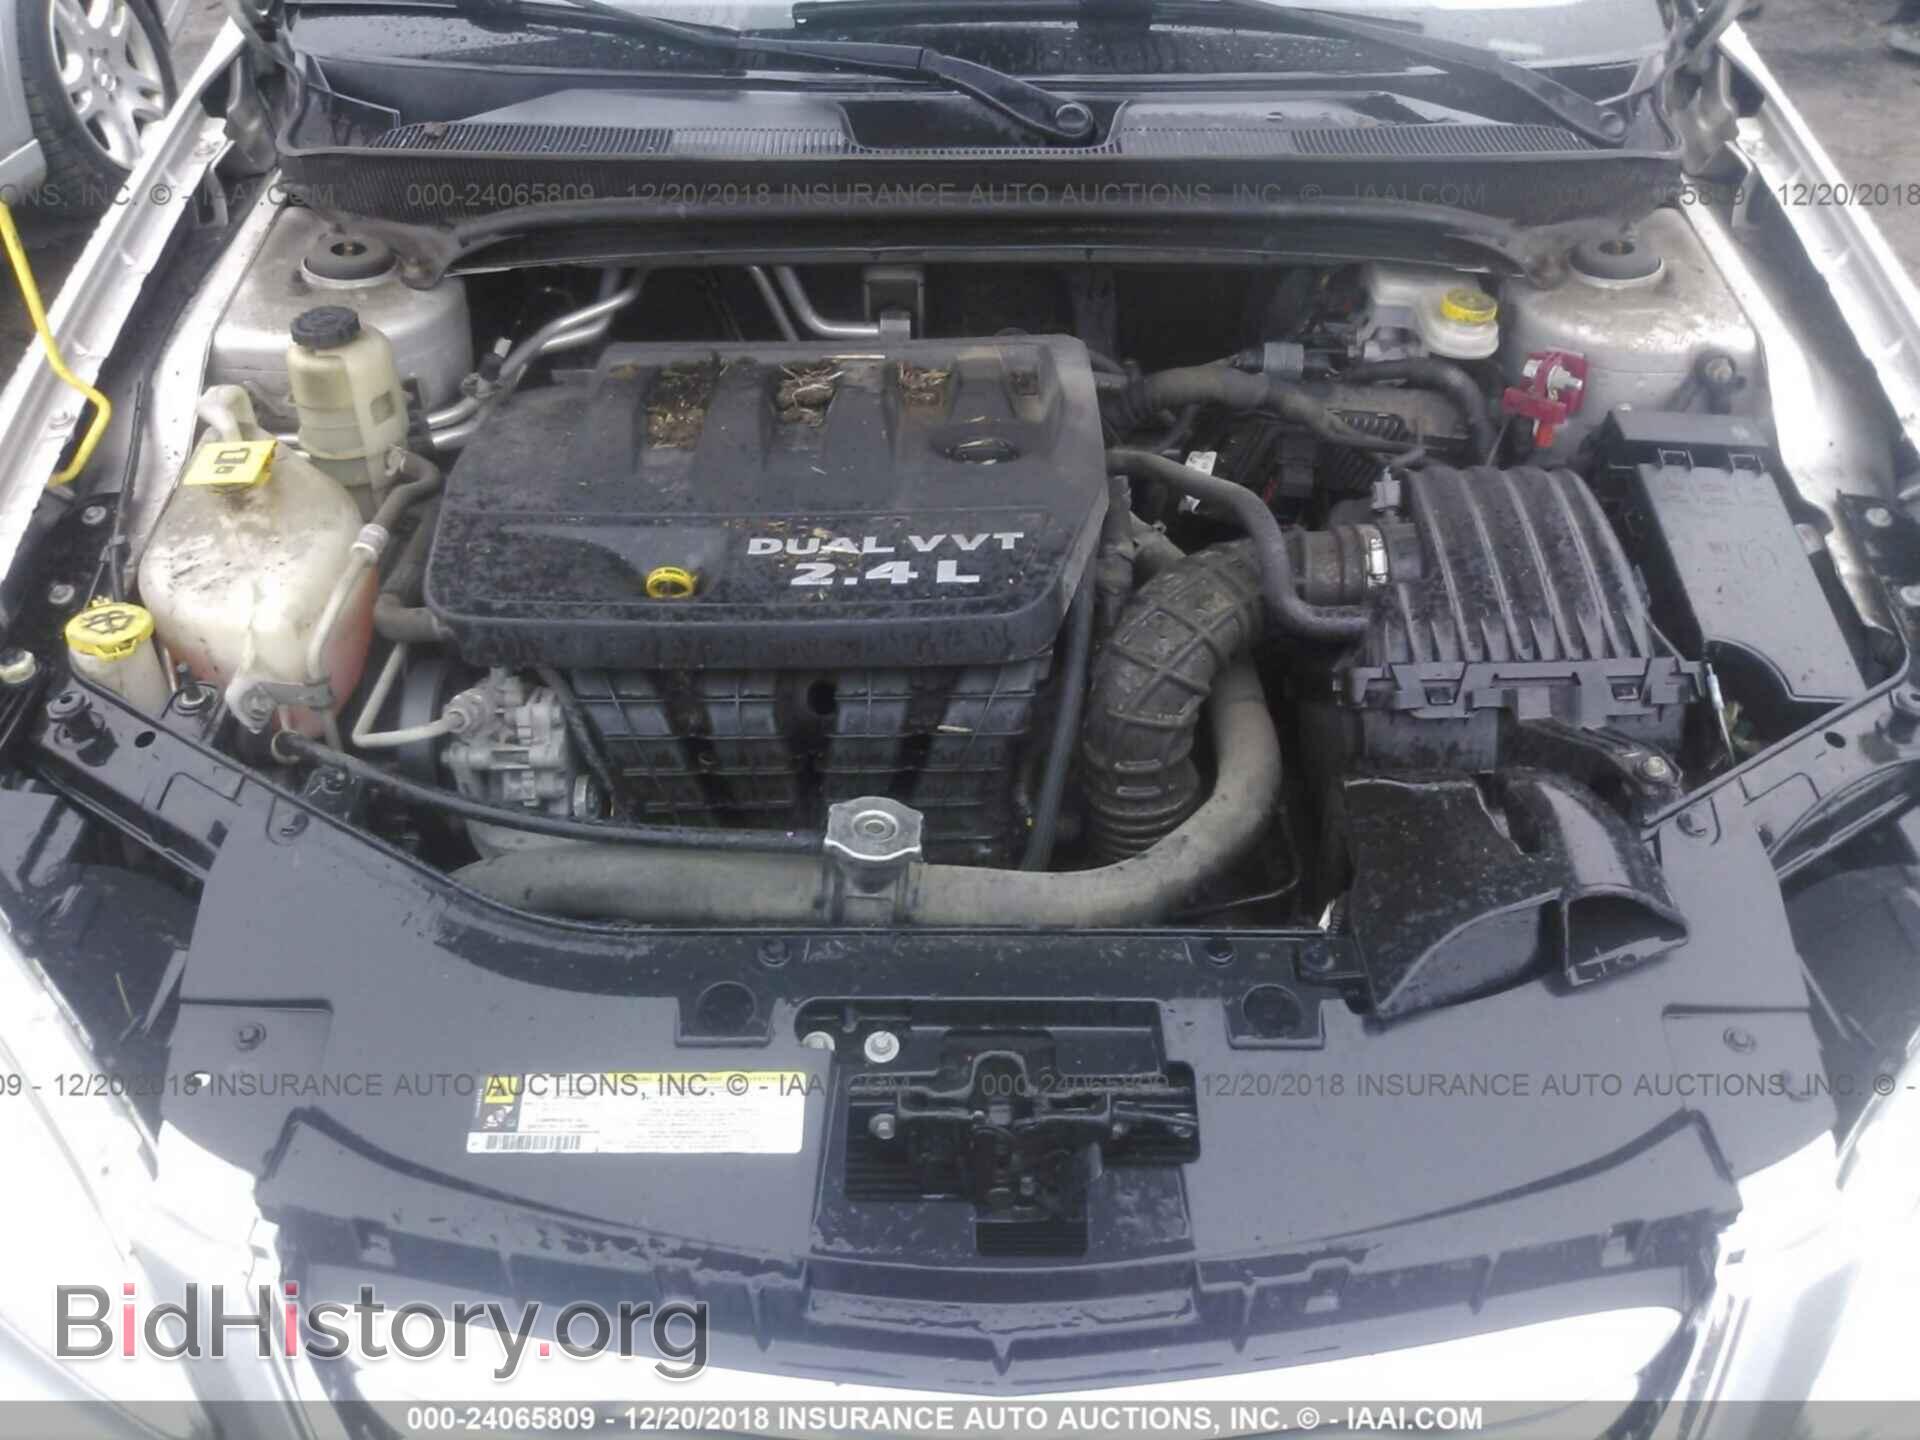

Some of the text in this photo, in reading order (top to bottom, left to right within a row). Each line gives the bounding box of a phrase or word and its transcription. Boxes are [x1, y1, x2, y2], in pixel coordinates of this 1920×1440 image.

[747, 532, 1024, 556] DUAL VVT
[936, 559, 980, 584] L
